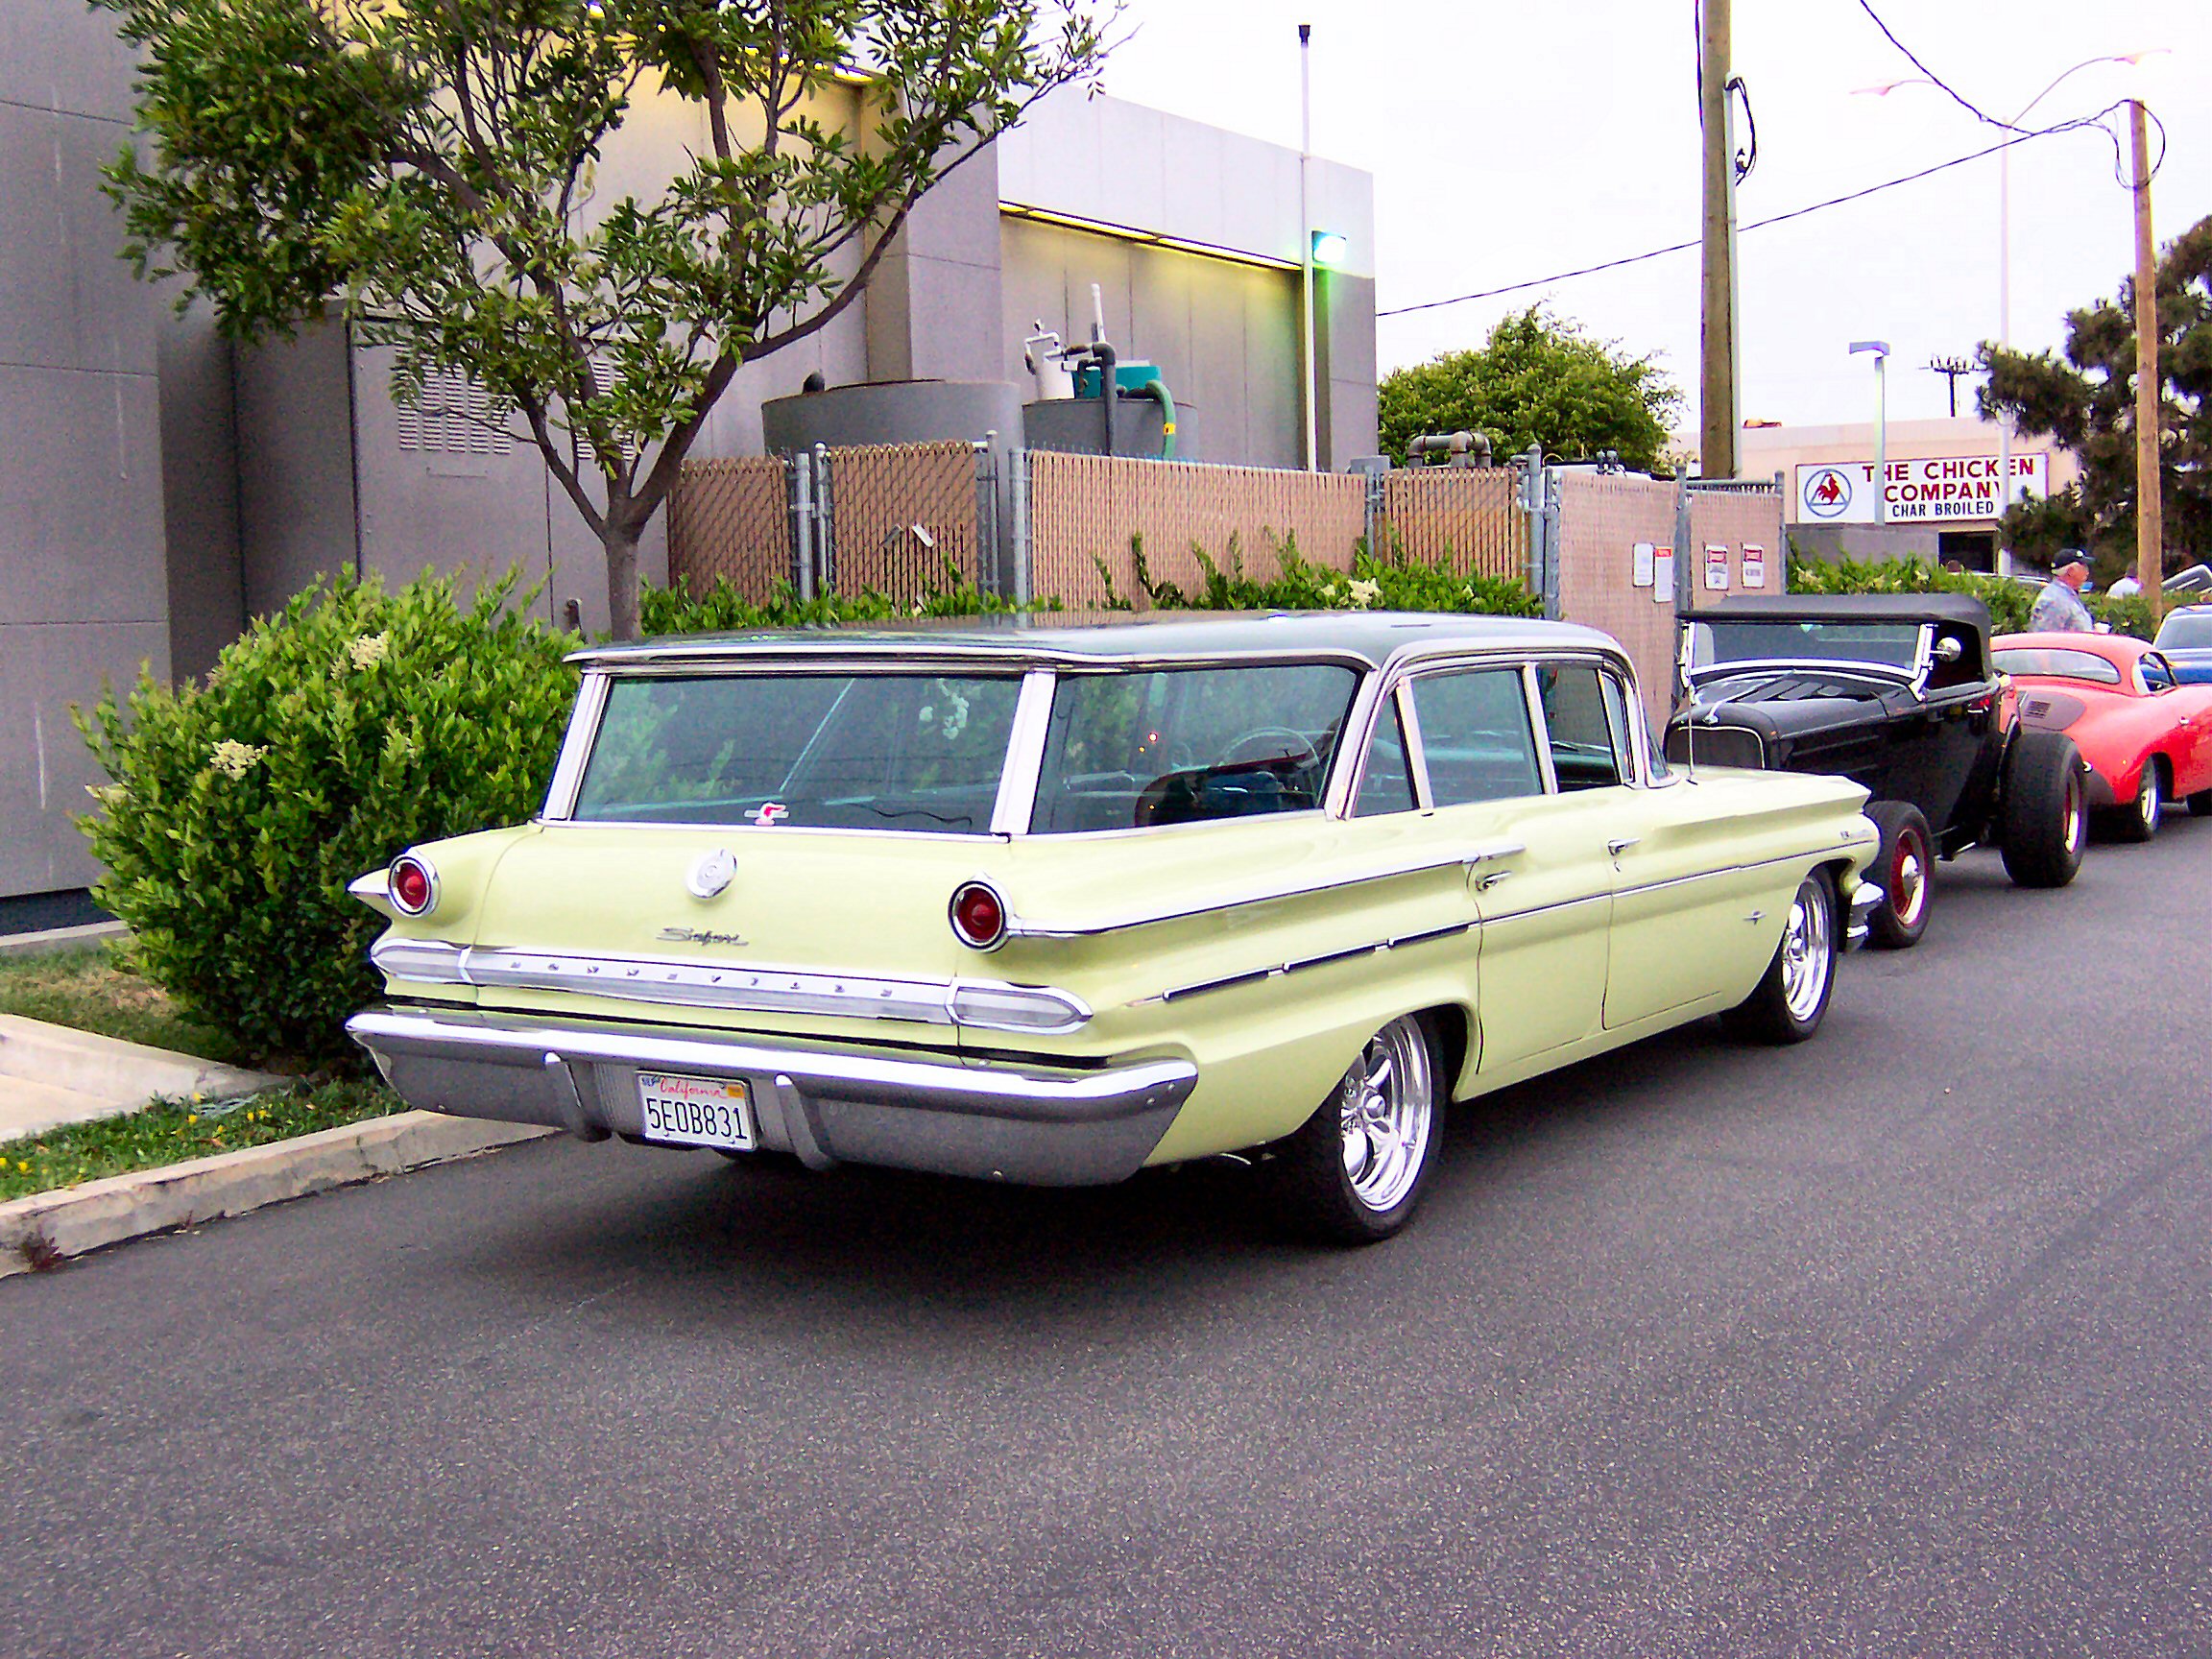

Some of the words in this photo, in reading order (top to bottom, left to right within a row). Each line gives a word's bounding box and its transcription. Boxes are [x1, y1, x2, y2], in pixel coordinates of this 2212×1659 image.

[1862, 463, 1910, 483] THE
[1892, 504, 1926, 517] CHAR
[1935, 500, 1994, 516] BROILED
[660, 1076, 727, 1100] California
